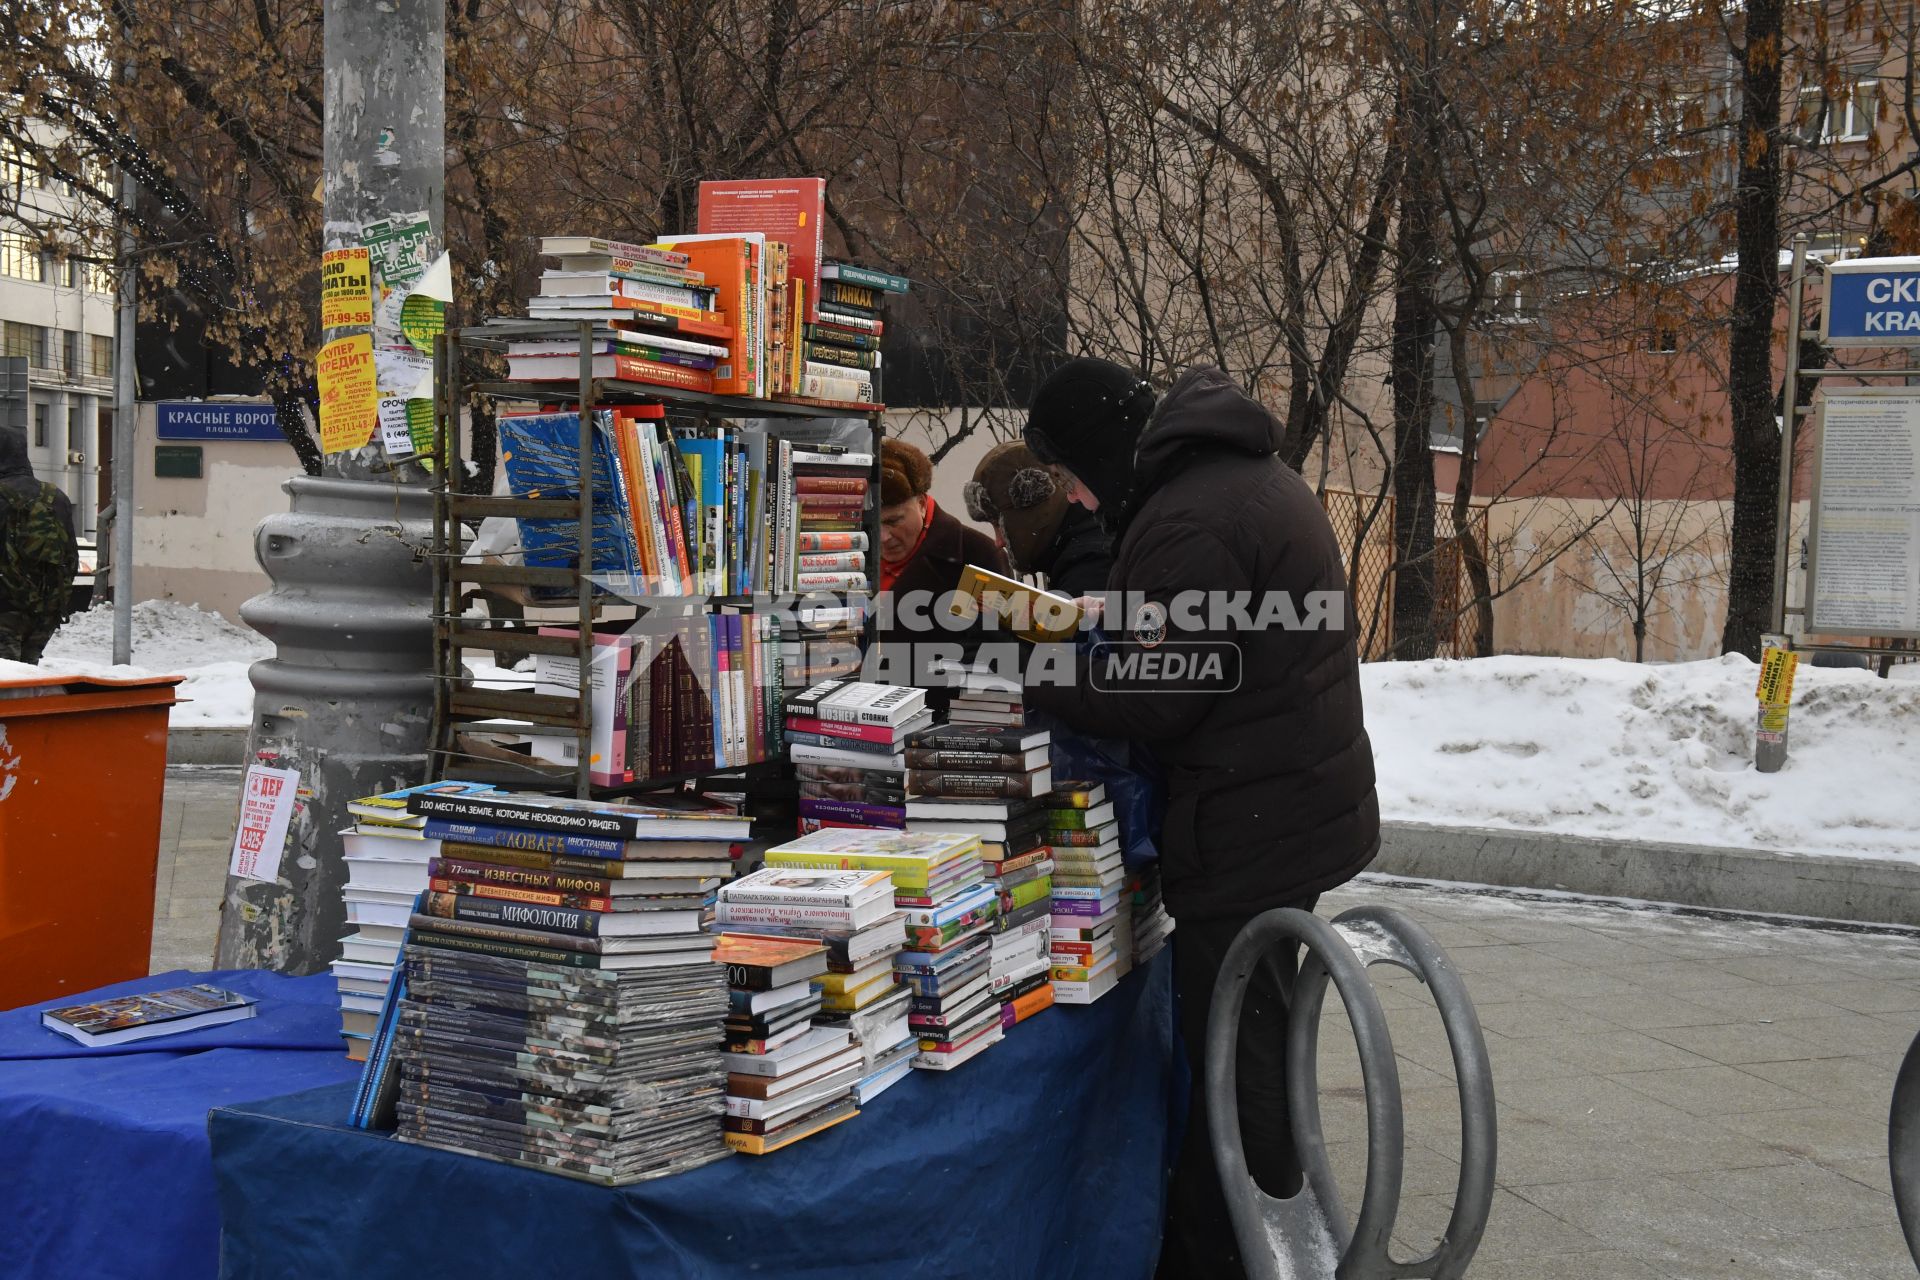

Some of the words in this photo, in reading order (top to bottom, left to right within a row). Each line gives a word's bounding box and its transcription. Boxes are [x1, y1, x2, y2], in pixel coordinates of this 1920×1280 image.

[614, 259, 634, 269] 5000
[836, 283, 873, 308] ТАНКАХ
[1864, 311, 1920, 331] KRA
[323, 342, 355, 359] СУПЕР
[812, 346, 839, 360] КРЕЙСЕРА
[319, 352, 369, 374] КРЕДИТ
[168, 411, 231, 424] КРАСНЫЕ
[236, 413, 276, 425] ВОРОТ
[614, 457, 628, 503] МИРОВЫЕ
[623, 505, 637, 546] РЕКОРДЫ
[672, 509, 684, 549] ФИТНЕС
[1762, 661, 1773, 689] СДАЮ
[1766, 651, 1783, 701] КОМНАТЫ
[786, 704, 814, 715] ПРОТИВО
[820, 708, 855, 723] ПОЗНЕР
[861, 712, 889, 723] СТОЯНИЕ
[419, 800, 434, 810] 100
[434, 802, 454, 812] МЕСТ
[455, 804, 467, 814] НА
[468, 805, 494, 818] ЗЕМЛЕ,
[495, 808, 530, 822] КОТОРЫЕ
[530, 811, 586, 828] НЕОБХОДИМО
[587, 818, 621, 831] УВИДЕТЬ
[449, 824, 477, 834] ПОЛНЫЙ
[567, 836, 618, 851] ИНОСТРАННЫХ
[450, 865, 461, 875] 77
[484, 868, 550, 886] ИЗВЕСТНЫХ
[556, 877, 601, 892] МИФОВ
[478, 886, 535, 901] ДРЕВНЕГРЕЧЕСКИЕ
[535, 893, 557, 903] МИФЫ
[729, 893, 759, 901] ПАТРИАРХ
[759, 894, 780, 902] ТИХОН
[807, 896, 844, 905] ИЗБРАННИК
[501, 905, 580, 929] МИФОЛОГИЯ
[766, 916, 791, 926] Жизнь
[439, 938, 482, 950] МОСКОВСКОГО
[483, 943, 508, 953] ПАЛАТЫ
[514, 948, 540, 958] ДВОРЦЫ
[727, 1138, 748, 1148] МИРА
